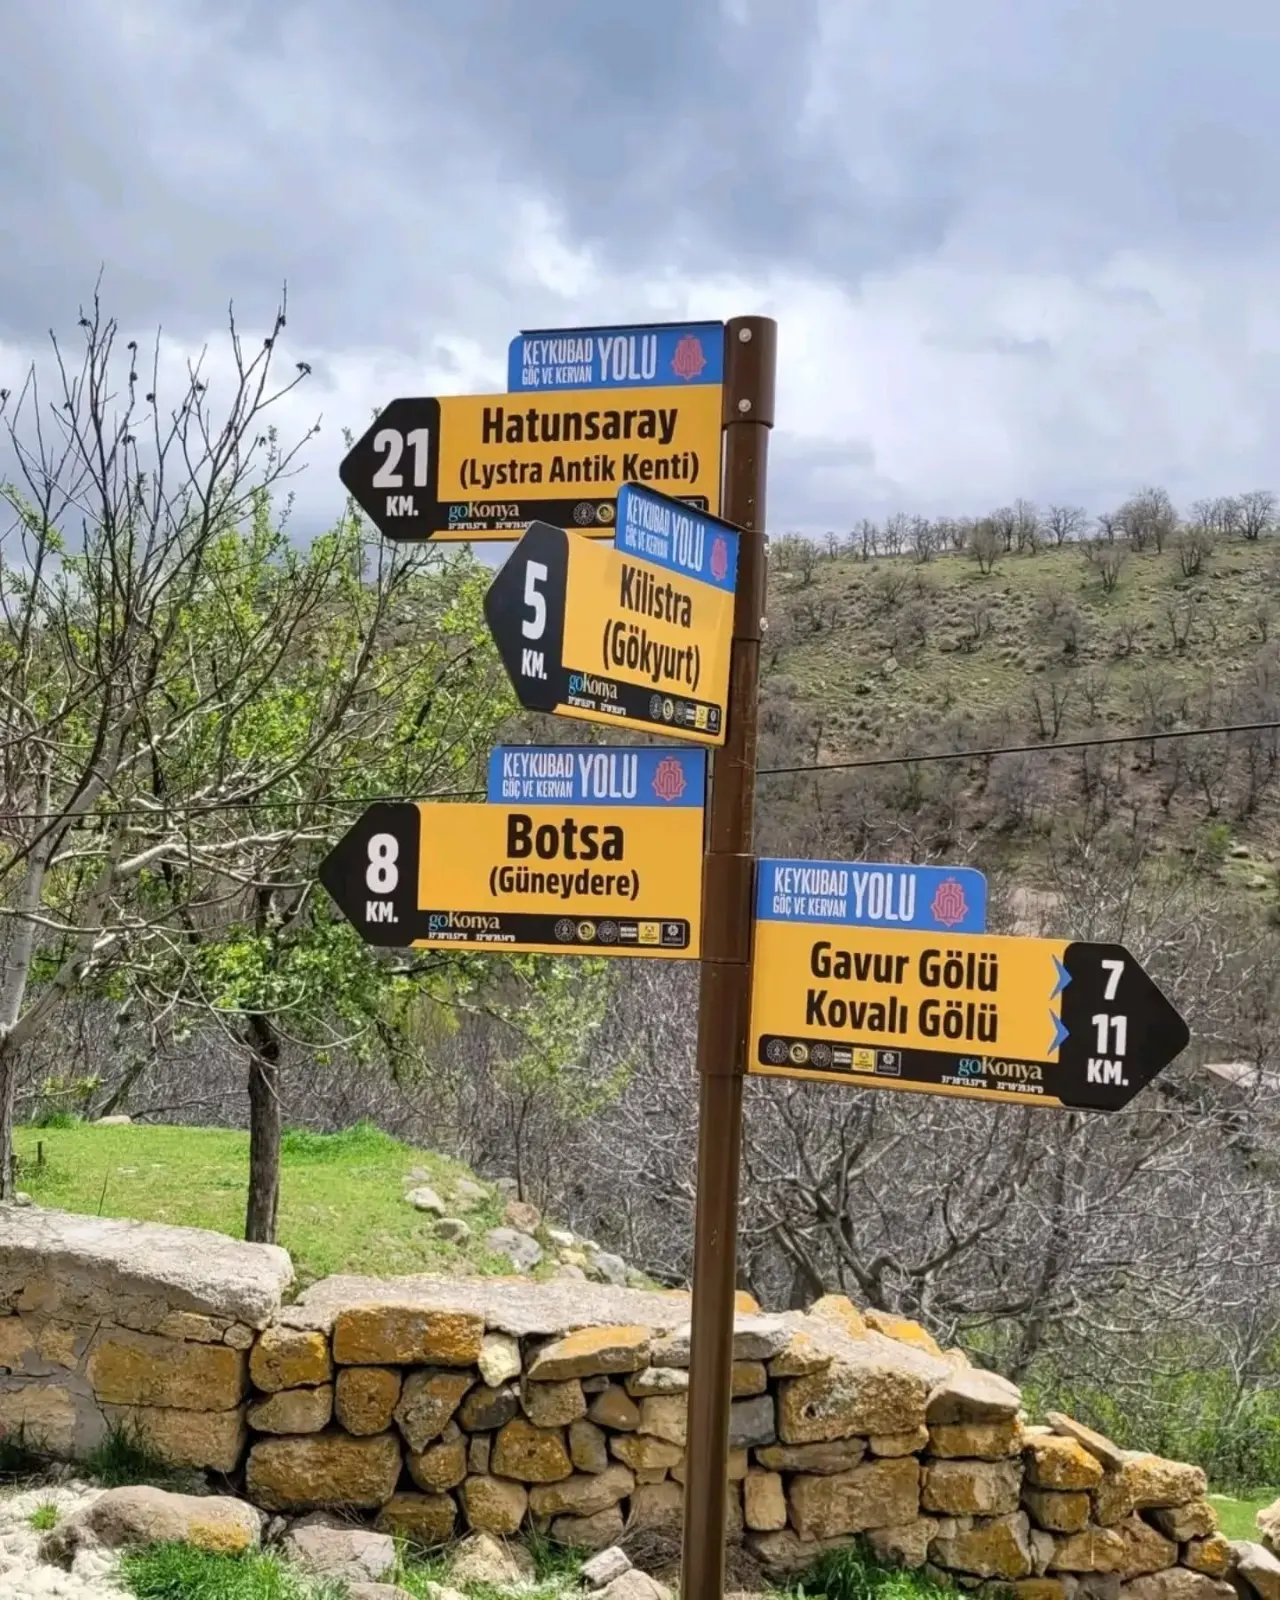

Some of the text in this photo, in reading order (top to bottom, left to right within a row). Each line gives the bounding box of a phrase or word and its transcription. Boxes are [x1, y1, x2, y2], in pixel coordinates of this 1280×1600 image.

[522, 335, 657, 381] KEYKUBAD YOLU
[522, 366, 592, 387] GÖÇ VE KERVAN
[482, 407, 678, 444] Hatunsaray
[372, 428, 429, 488] 21
[460, 452, 700, 489] (Lystra Antik Kenti)
[386, 495, 419, 517] KM.
[449, 501, 519, 521] goKonya
[627, 492, 705, 572] KEYKUBAD YOLU
[522, 560, 548, 640] 5
[620, 564, 692, 628] Kilistra
[521, 649, 547, 680] KM.
[603, 619, 700, 692] (Gökyurt)
[569, 673, 618, 703] goKonya
[502, 779, 573, 800] GÖÇ VE KERVAN
[503, 752, 638, 799] KEYKUBAD YOLU
[507, 814, 624, 861] Botsa
[365, 833, 399, 894] 8
[489, 866, 640, 901] (Güneydere)
[774, 868, 916, 922] KEYKUBAD YOLU
[366, 901, 398, 923] KM.
[428, 912, 500, 934] goKonya
[773, 894, 847, 918] GÖÇ VE KERVAN
[810, 941, 999, 992] Gavur Gölü
[1100, 960, 1125, 1001] 7
[805, 990, 999, 1043] Kovalı Gölü
[1092, 1014, 1127, 1056] 11
[958, 1057, 1043, 1083] goKonya
[1087, 1059, 1129, 1086] KM.
